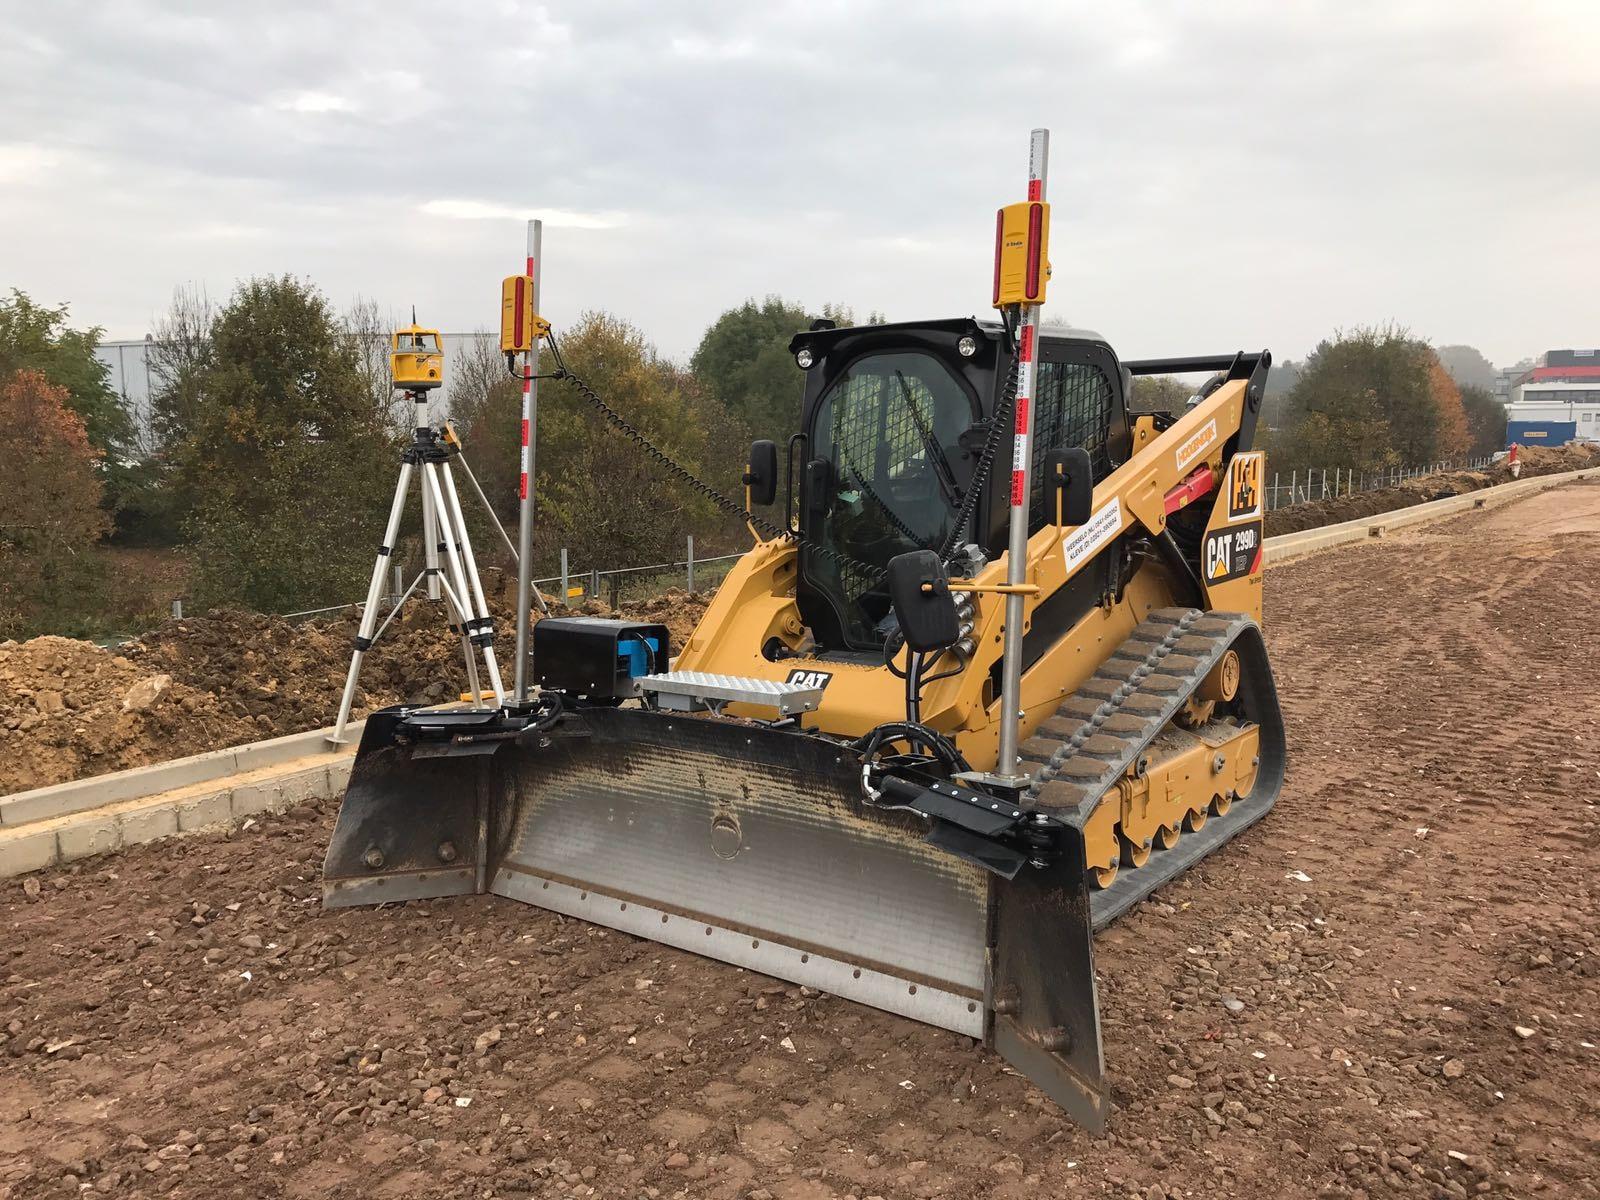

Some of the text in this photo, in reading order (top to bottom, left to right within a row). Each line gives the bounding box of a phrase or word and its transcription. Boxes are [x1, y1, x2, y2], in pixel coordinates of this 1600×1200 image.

[1069, 545, 1084, 560] KLEVE
[1207, 533, 1232, 580] CAT
[790, 671, 829, 689] CAT
